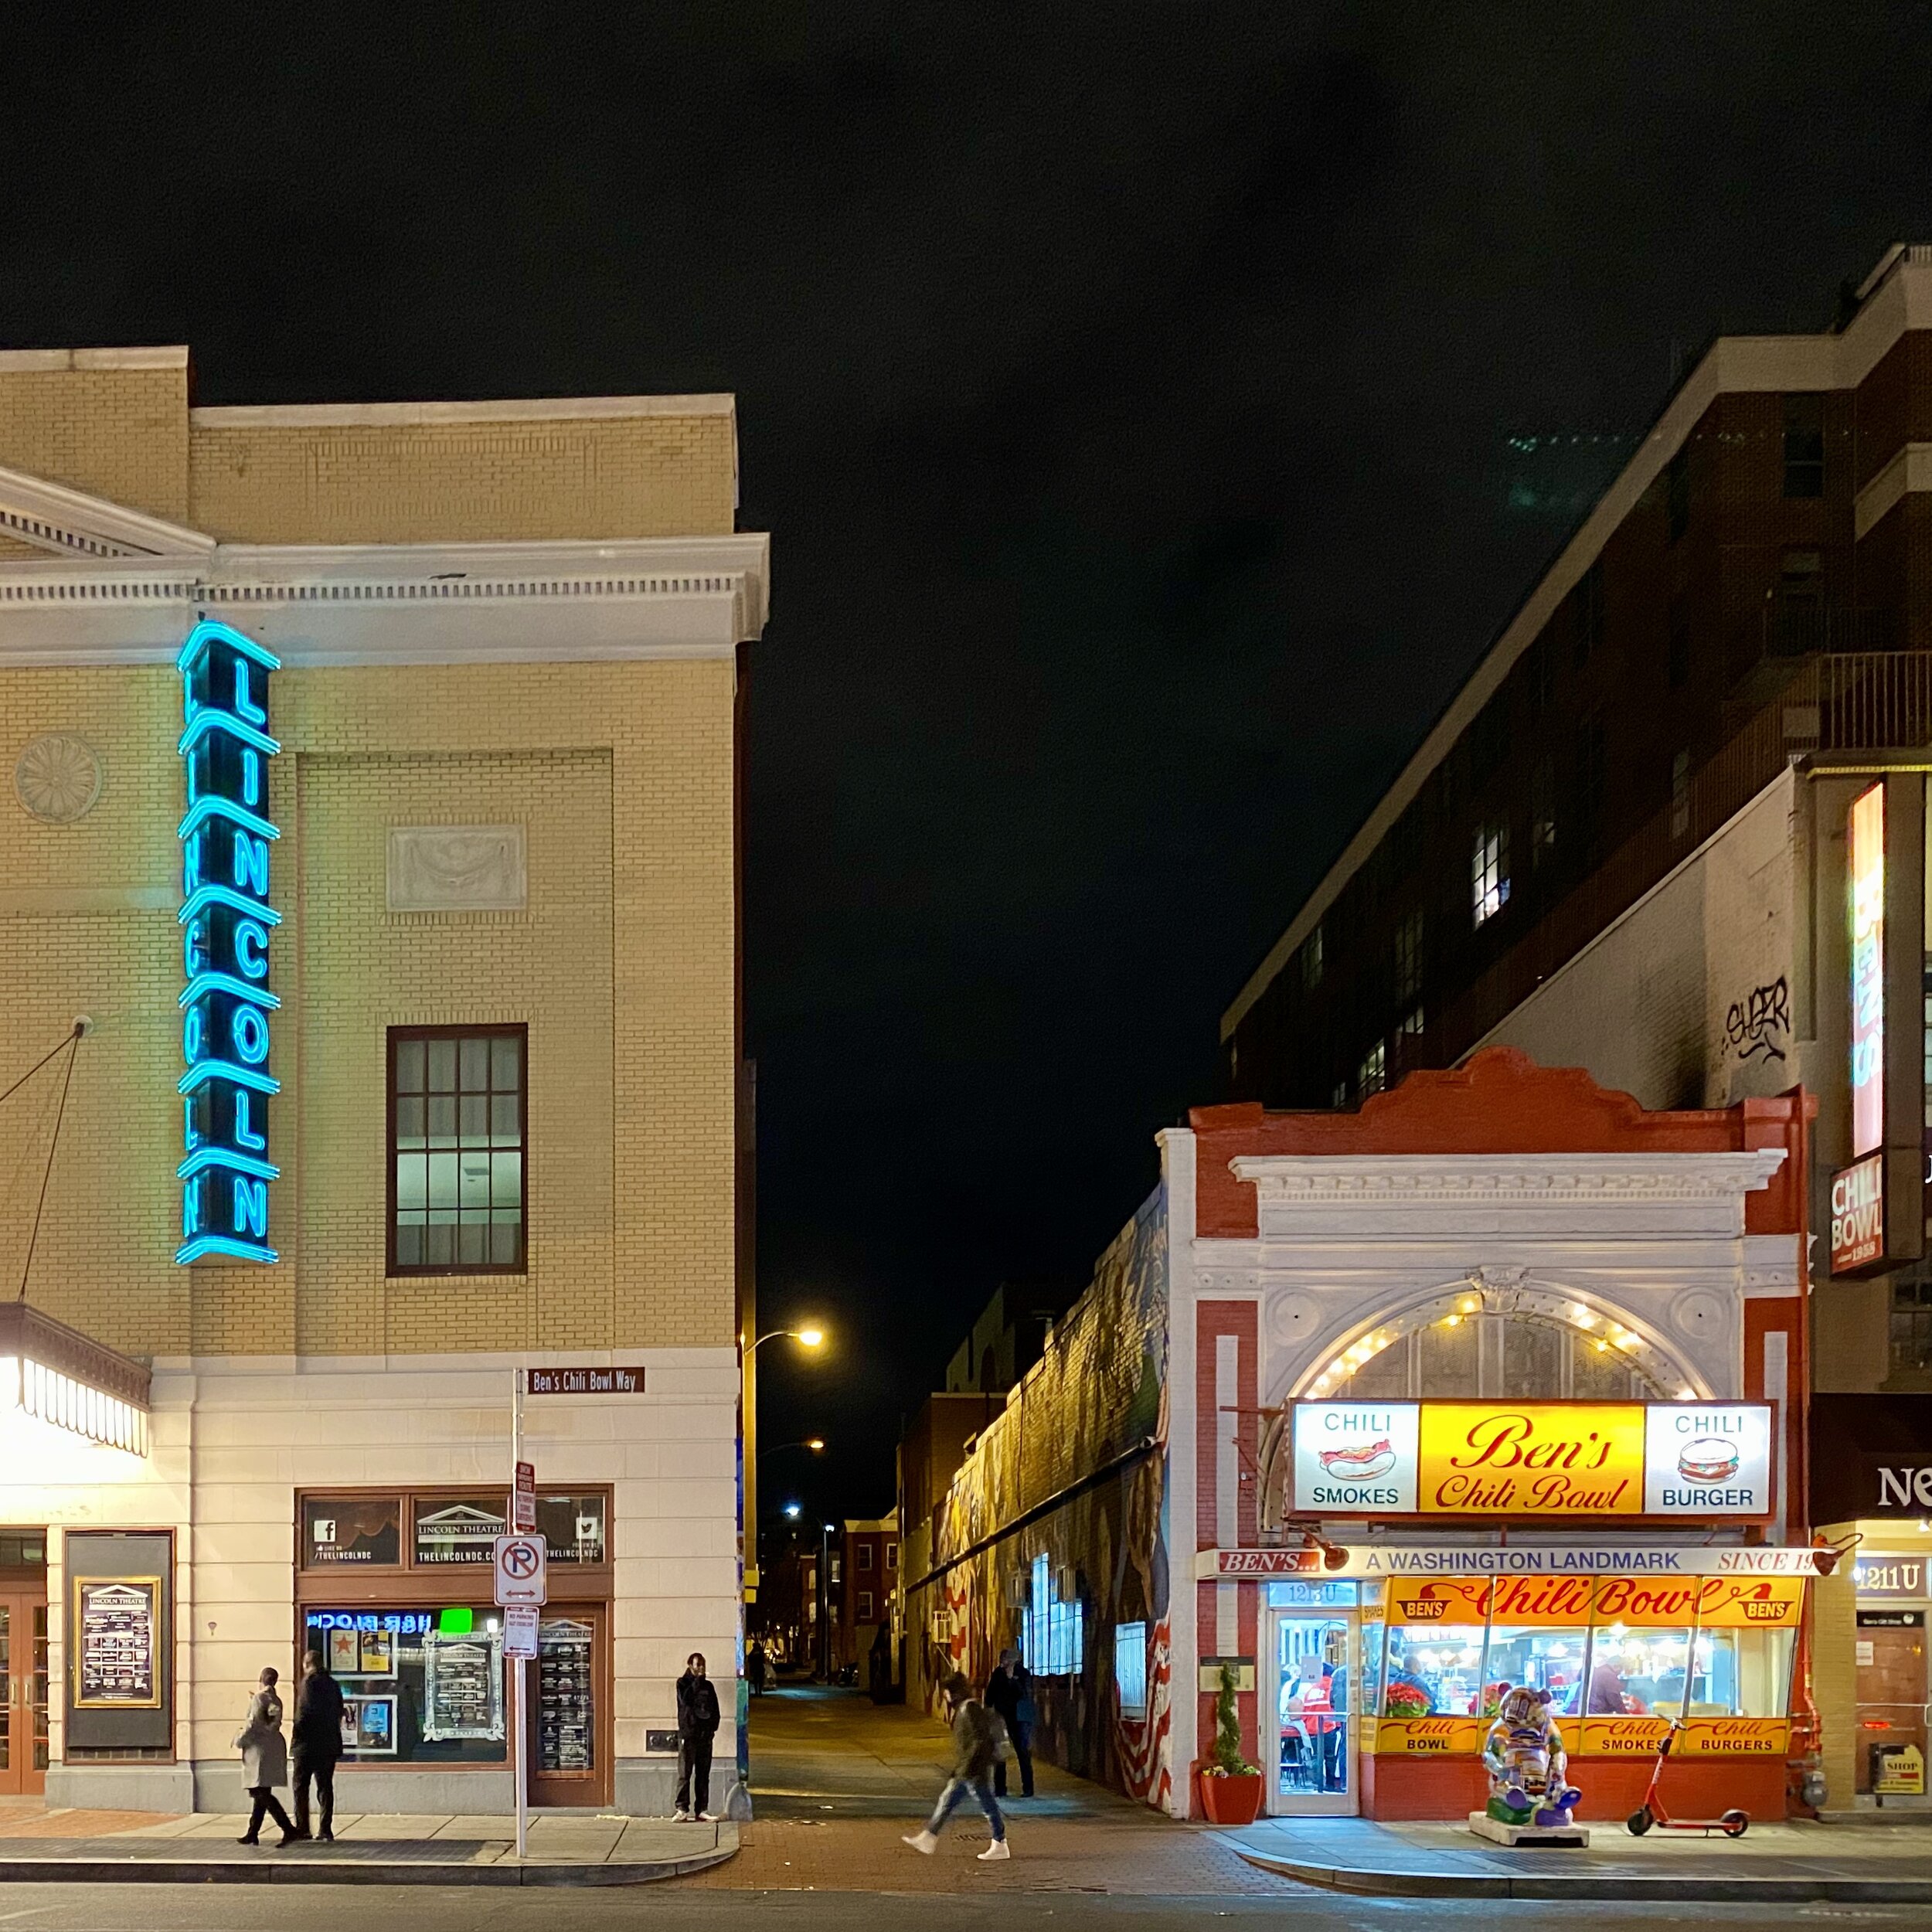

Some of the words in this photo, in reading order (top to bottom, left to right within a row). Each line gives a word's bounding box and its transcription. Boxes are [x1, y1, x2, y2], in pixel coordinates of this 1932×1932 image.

[233, 657, 269, 1238] LINCOLN
[1832, 1162, 1883, 1216] CHILI
[1832, 1202, 1883, 1252] BOWL
[533, 1371, 560, 1391] Ben's
[563, 1370, 586, 1390] Chili
[590, 1370, 612, 1390] Bowl
[616, 1370, 636, 1393] Way
[1324, 1413, 1391, 1431] CHILI
[1675, 1415, 1743, 1433] CHILI
[1450, 1414, 1613, 1469] Ben's
[1312, 1487, 1399, 1504] SMOKES
[1435, 1474, 1516, 1508] Chili
[1522, 1474, 1629, 1509] Bowl
[1662, 1489, 1753, 1506] BURGER
[418, 1525, 461, 1535] LINCOLN
[463, 1525, 503, 1535] THEATRE
[419, 1552, 495, 1562] THELINCOLNDC.CO
[1366, 1553, 1382, 1570] A
[1387, 1552, 1542, 1570] WASHINGTON
[1549, 1552, 1681, 1570] LANDMARK
[1717, 1552, 1788, 1570] SINCE
[1793, 1553, 1815, 1570] 19
[1901, 1564, 1920, 1590] U
[1325, 1584, 1338, 1601] U
[1475, 1577, 1593, 1617] Chili
[1595, 1577, 1724, 1617] Bowl
[1406, 1600, 1444, 1617] BEN'S
[1747, 1602, 1786, 1618] BEN'S
[1405, 1720, 1455, 1735] Chili
[1608, 1721, 1659, 1736] Chili
[1712, 1721, 1763, 1736] Chili
[1406, 1740, 1449, 1750] BOWL
[1601, 1740, 1663, 1750] SMOKES
[1701, 1740, 1774, 1750] BURGERS
